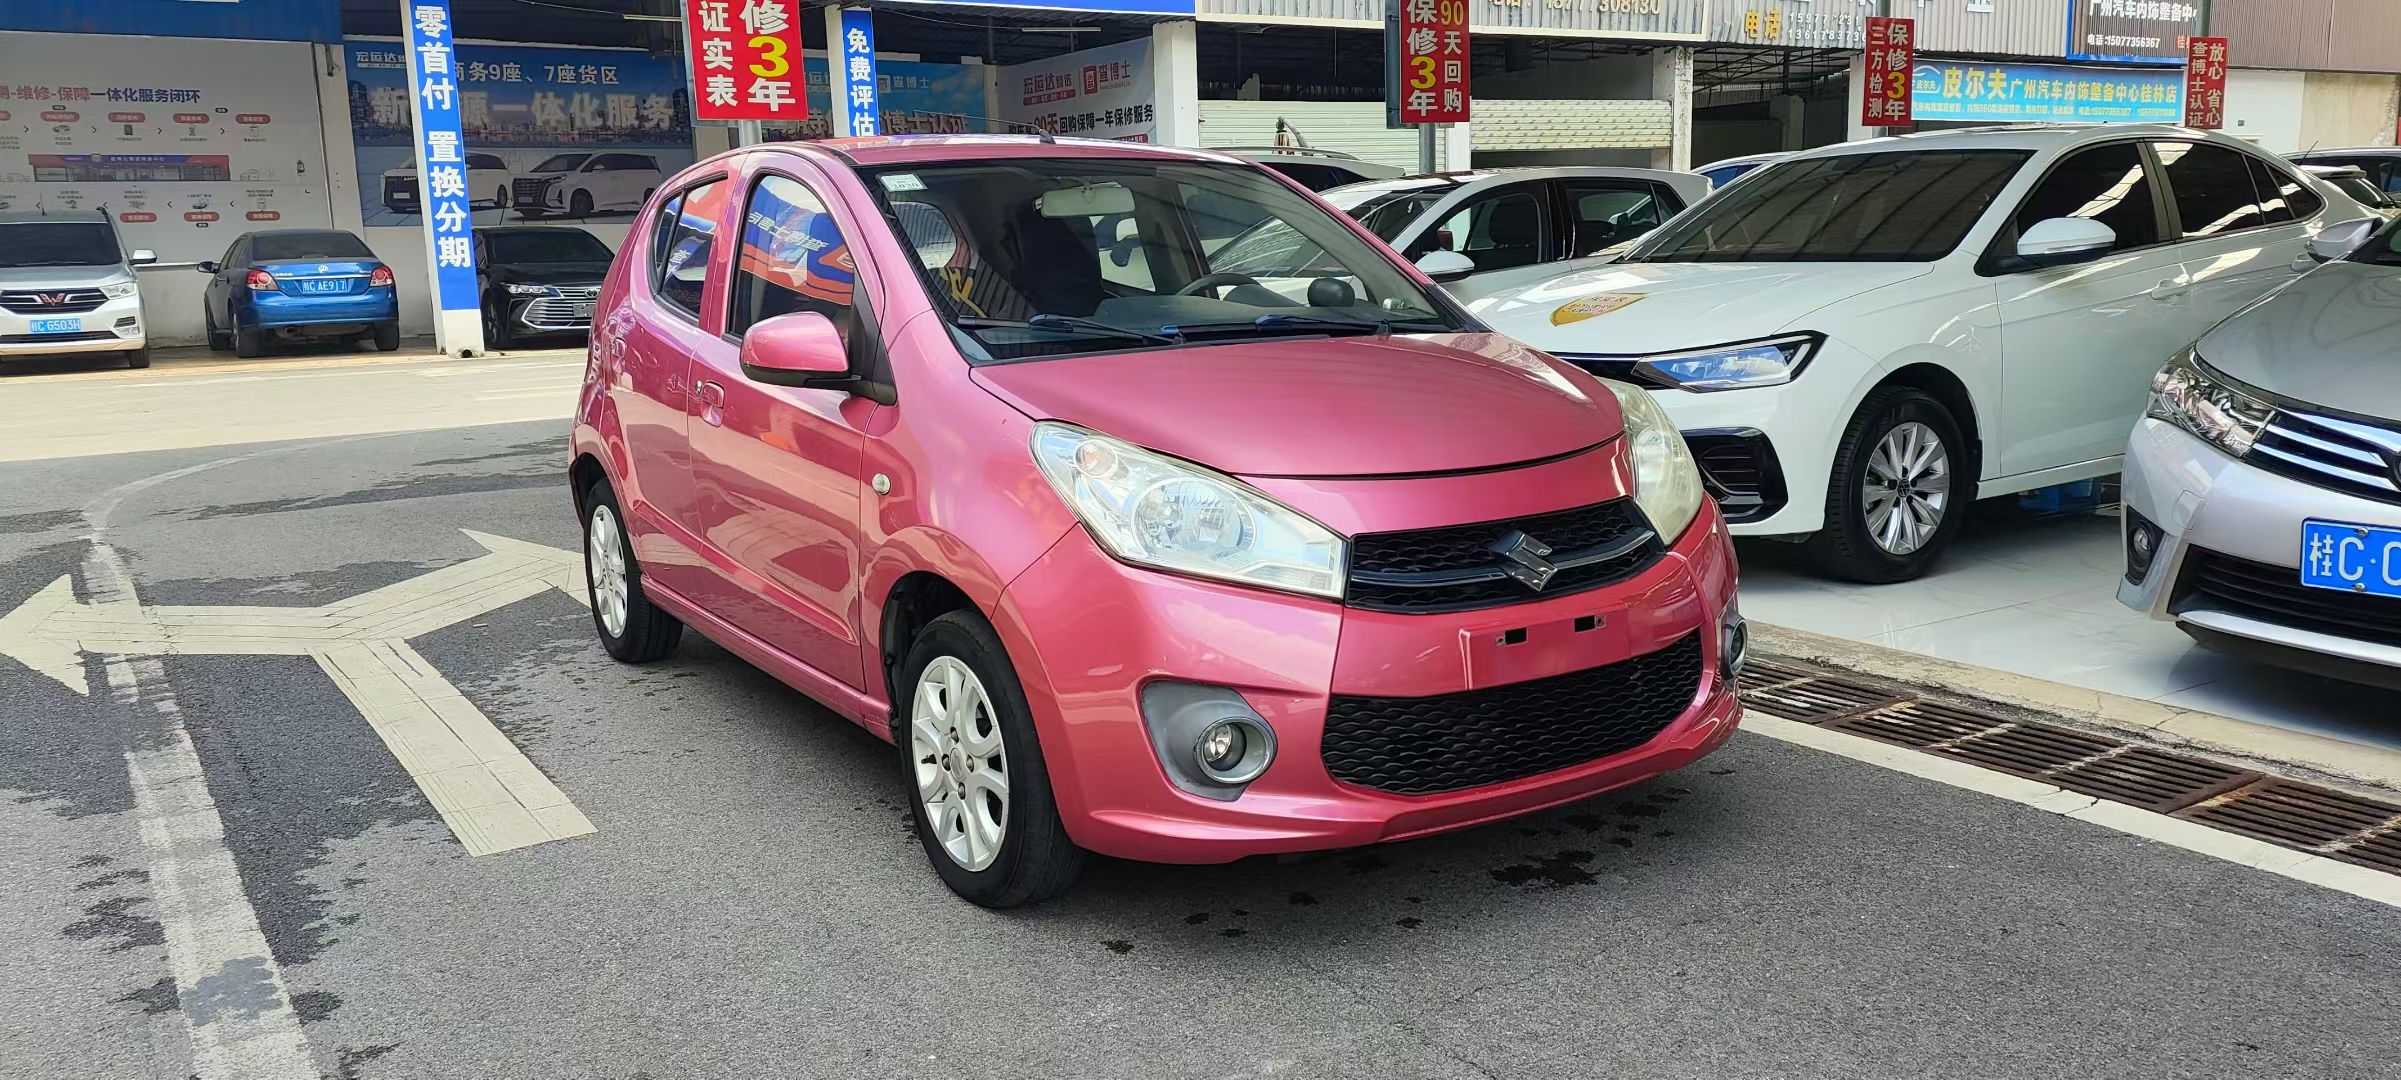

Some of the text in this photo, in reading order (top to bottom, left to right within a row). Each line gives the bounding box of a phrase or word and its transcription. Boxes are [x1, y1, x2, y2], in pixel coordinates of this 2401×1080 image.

[698, 0, 739, 108] 证实表
[738, 0, 797, 112] 修3年
[1406, 0, 1440, 117] 保修3年
[1440, 0, 1464, 113] 90天回购
[2089, 0, 2198, 22] 广州汽车内饰整备中
[371, 85, 675, 130] 新源一体化服务
[846, 28, 878, 137] 免费评估
[1868, 25, 1885, 119] 三方检测
[1884, 23, 1909, 121] 保修3年
[2187, 41, 2209, 127] 查博士认证
[2206, 43, 2225, 127] 放心 省心
[414, 4, 472, 269] 零首付 置换分期
